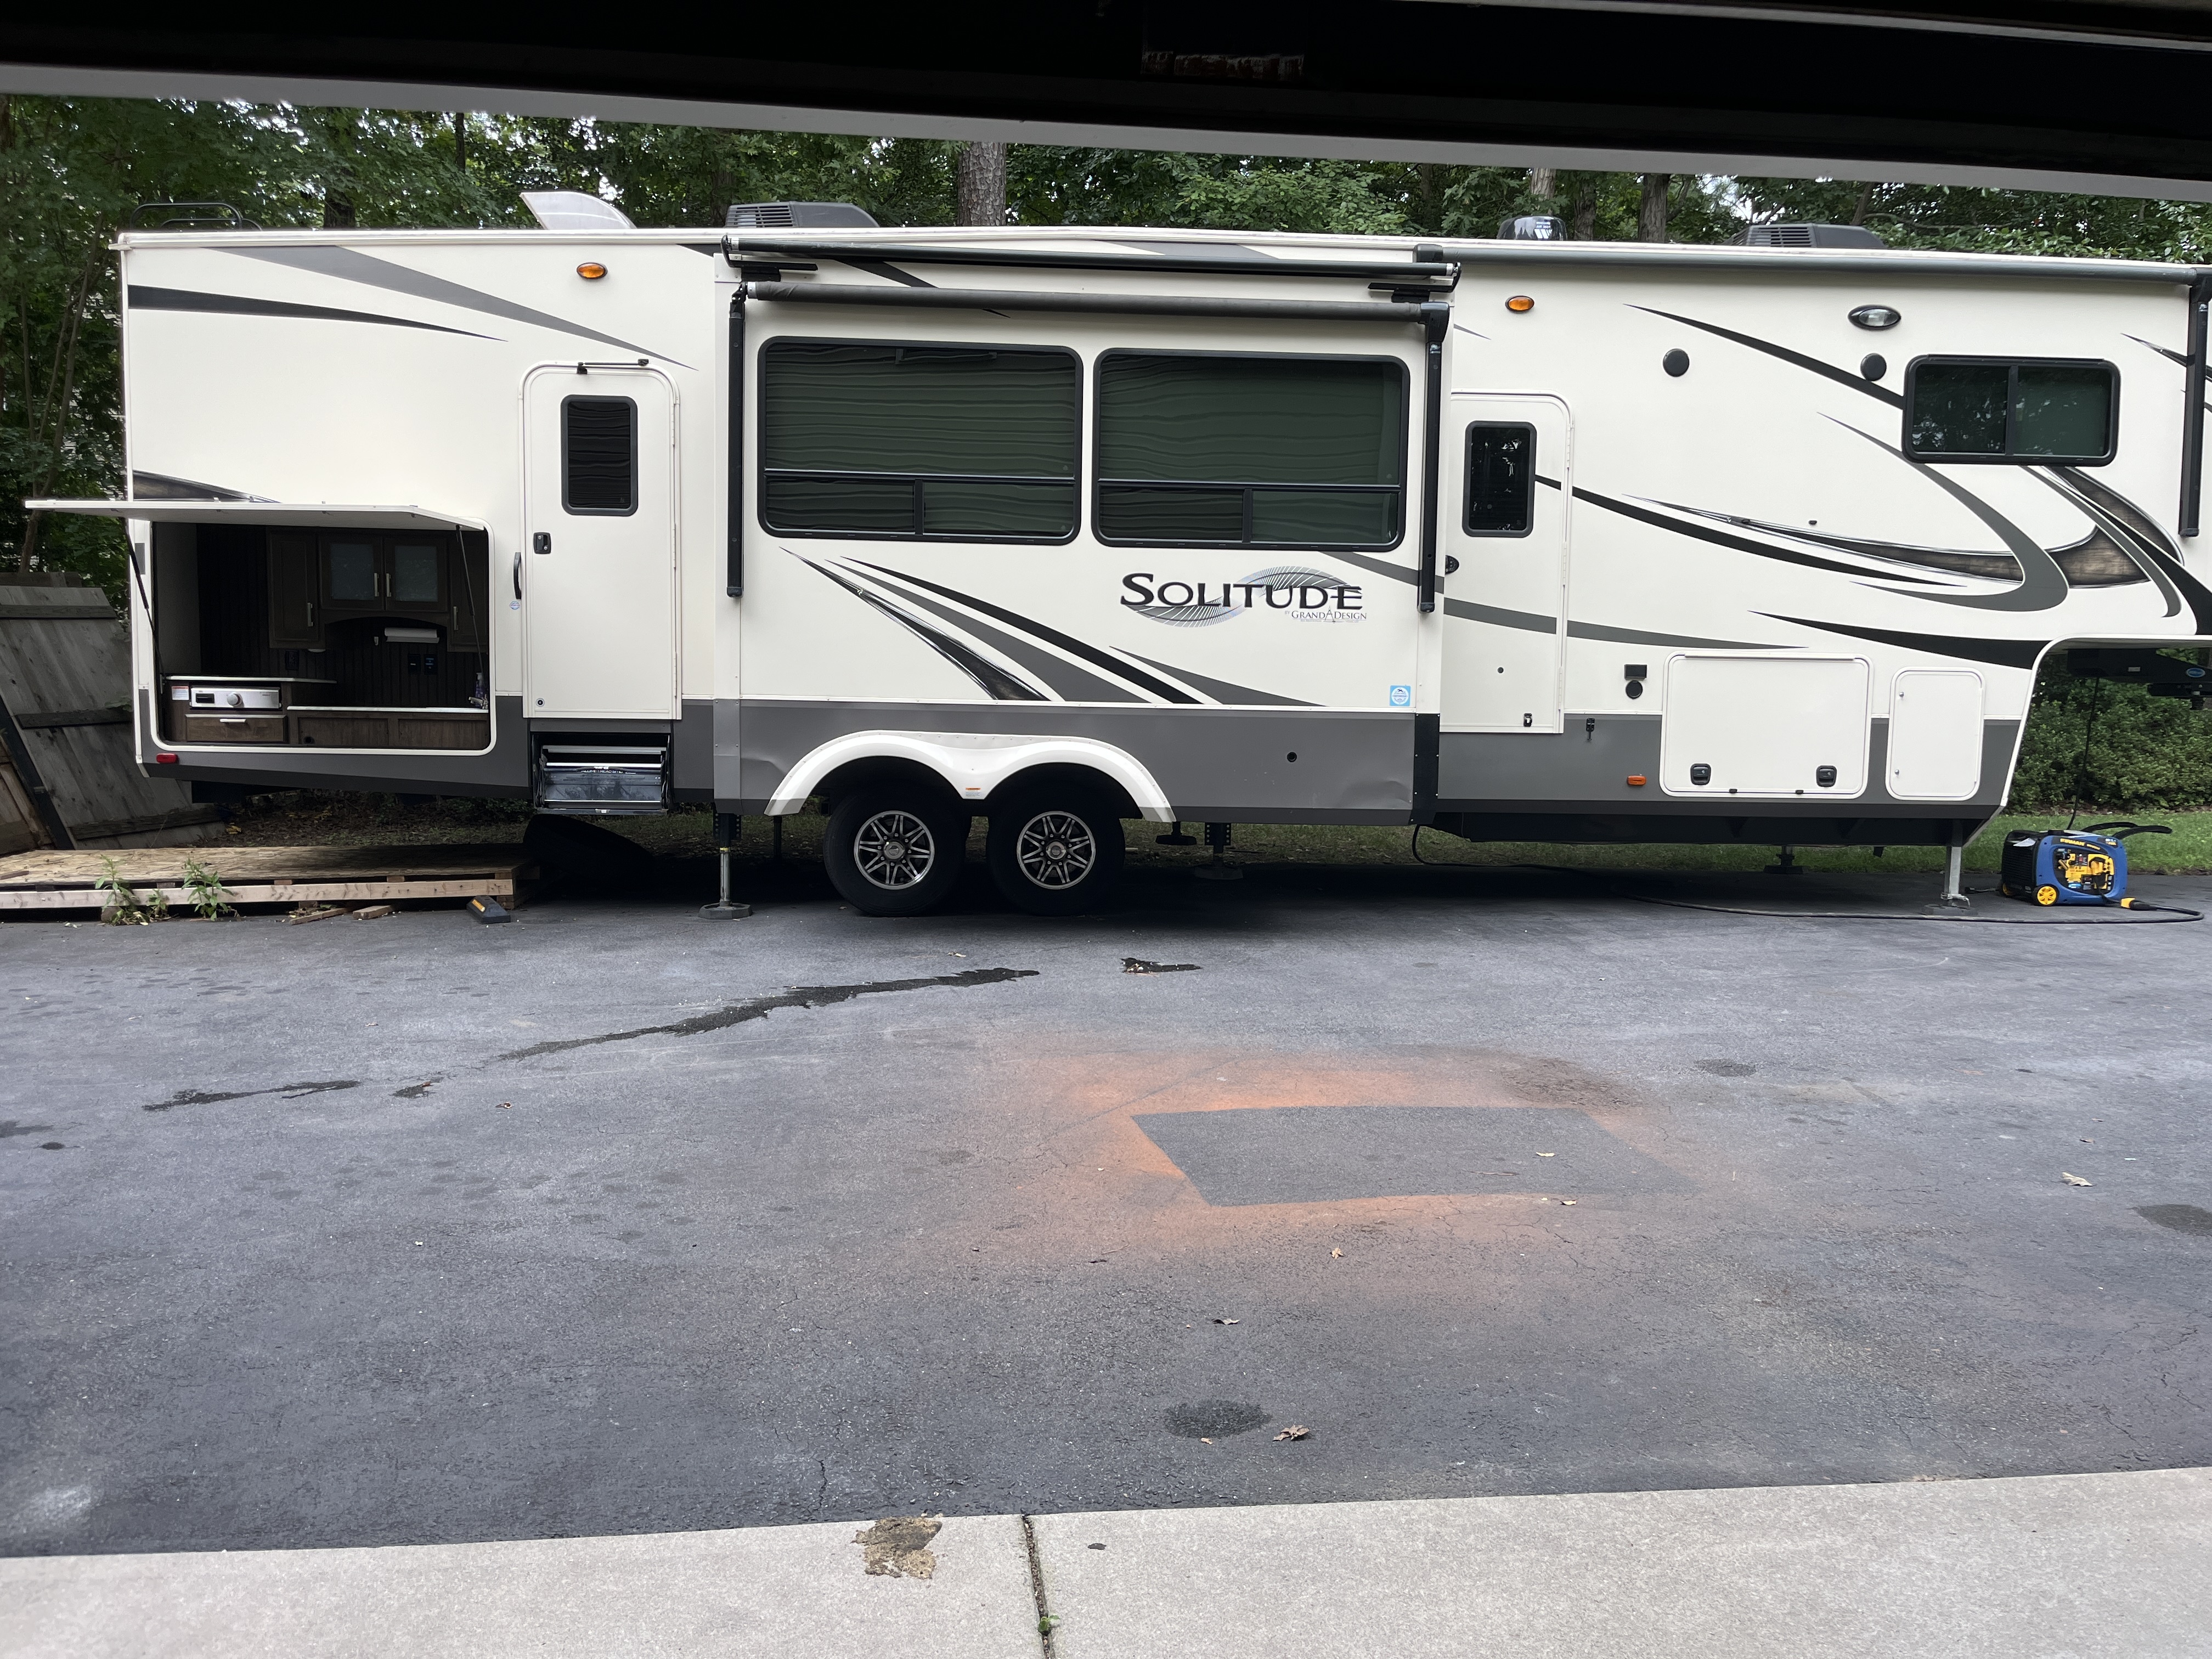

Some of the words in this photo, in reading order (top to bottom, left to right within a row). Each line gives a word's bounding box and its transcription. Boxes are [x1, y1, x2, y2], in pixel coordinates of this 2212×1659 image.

[1120, 572, 1363, 610] SOLITUDE
[1291, 610, 1325, 619] GRAND
[1334, 611, 1367, 619] DESIGN
